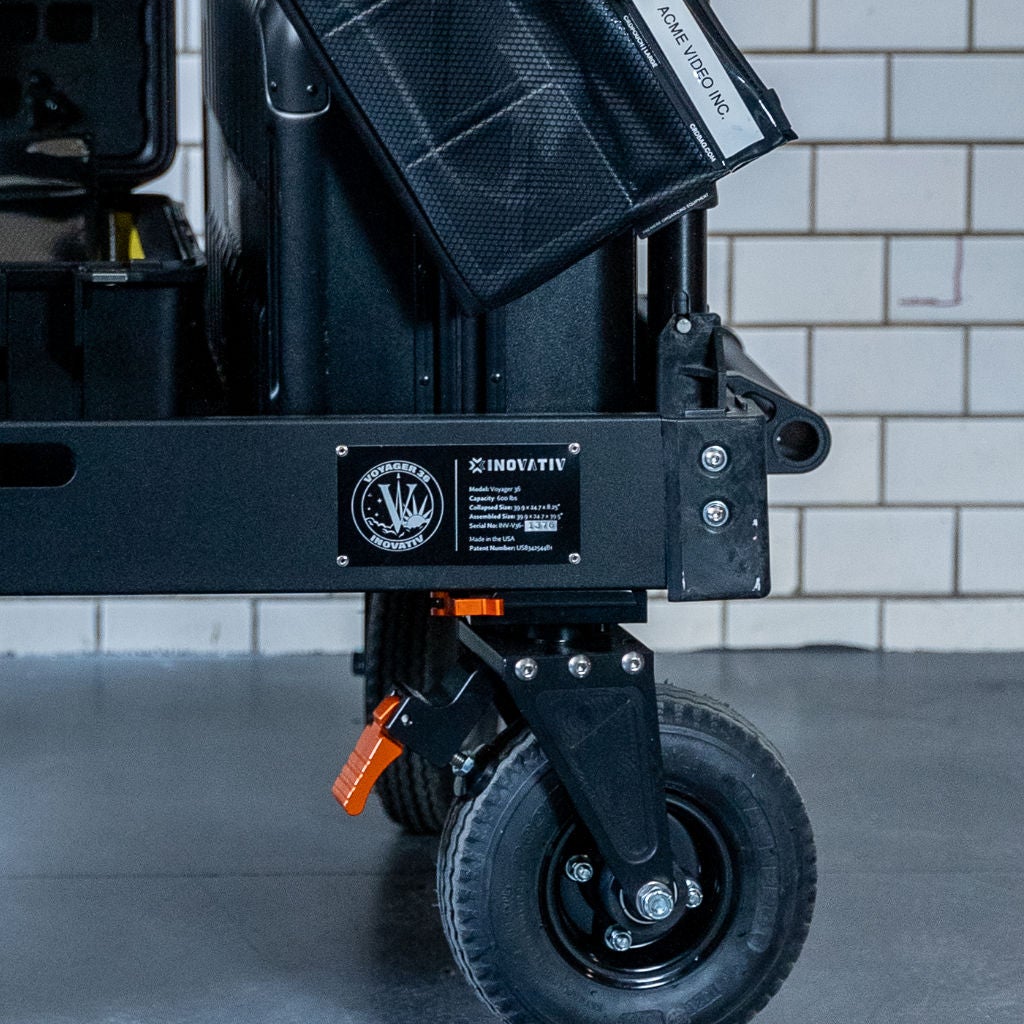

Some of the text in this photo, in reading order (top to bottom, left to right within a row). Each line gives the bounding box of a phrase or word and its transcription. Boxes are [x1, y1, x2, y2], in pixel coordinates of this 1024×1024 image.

[657, 4, 730, 120] ACME VIDEO INC.
[487, 458, 566, 472] INOVATIV
[363, 463, 418, 483] VOYAGER
[489, 486, 513, 494] Voyager
[370, 534, 424, 550] INOVATIV
[468, 544, 489, 552] Patent
